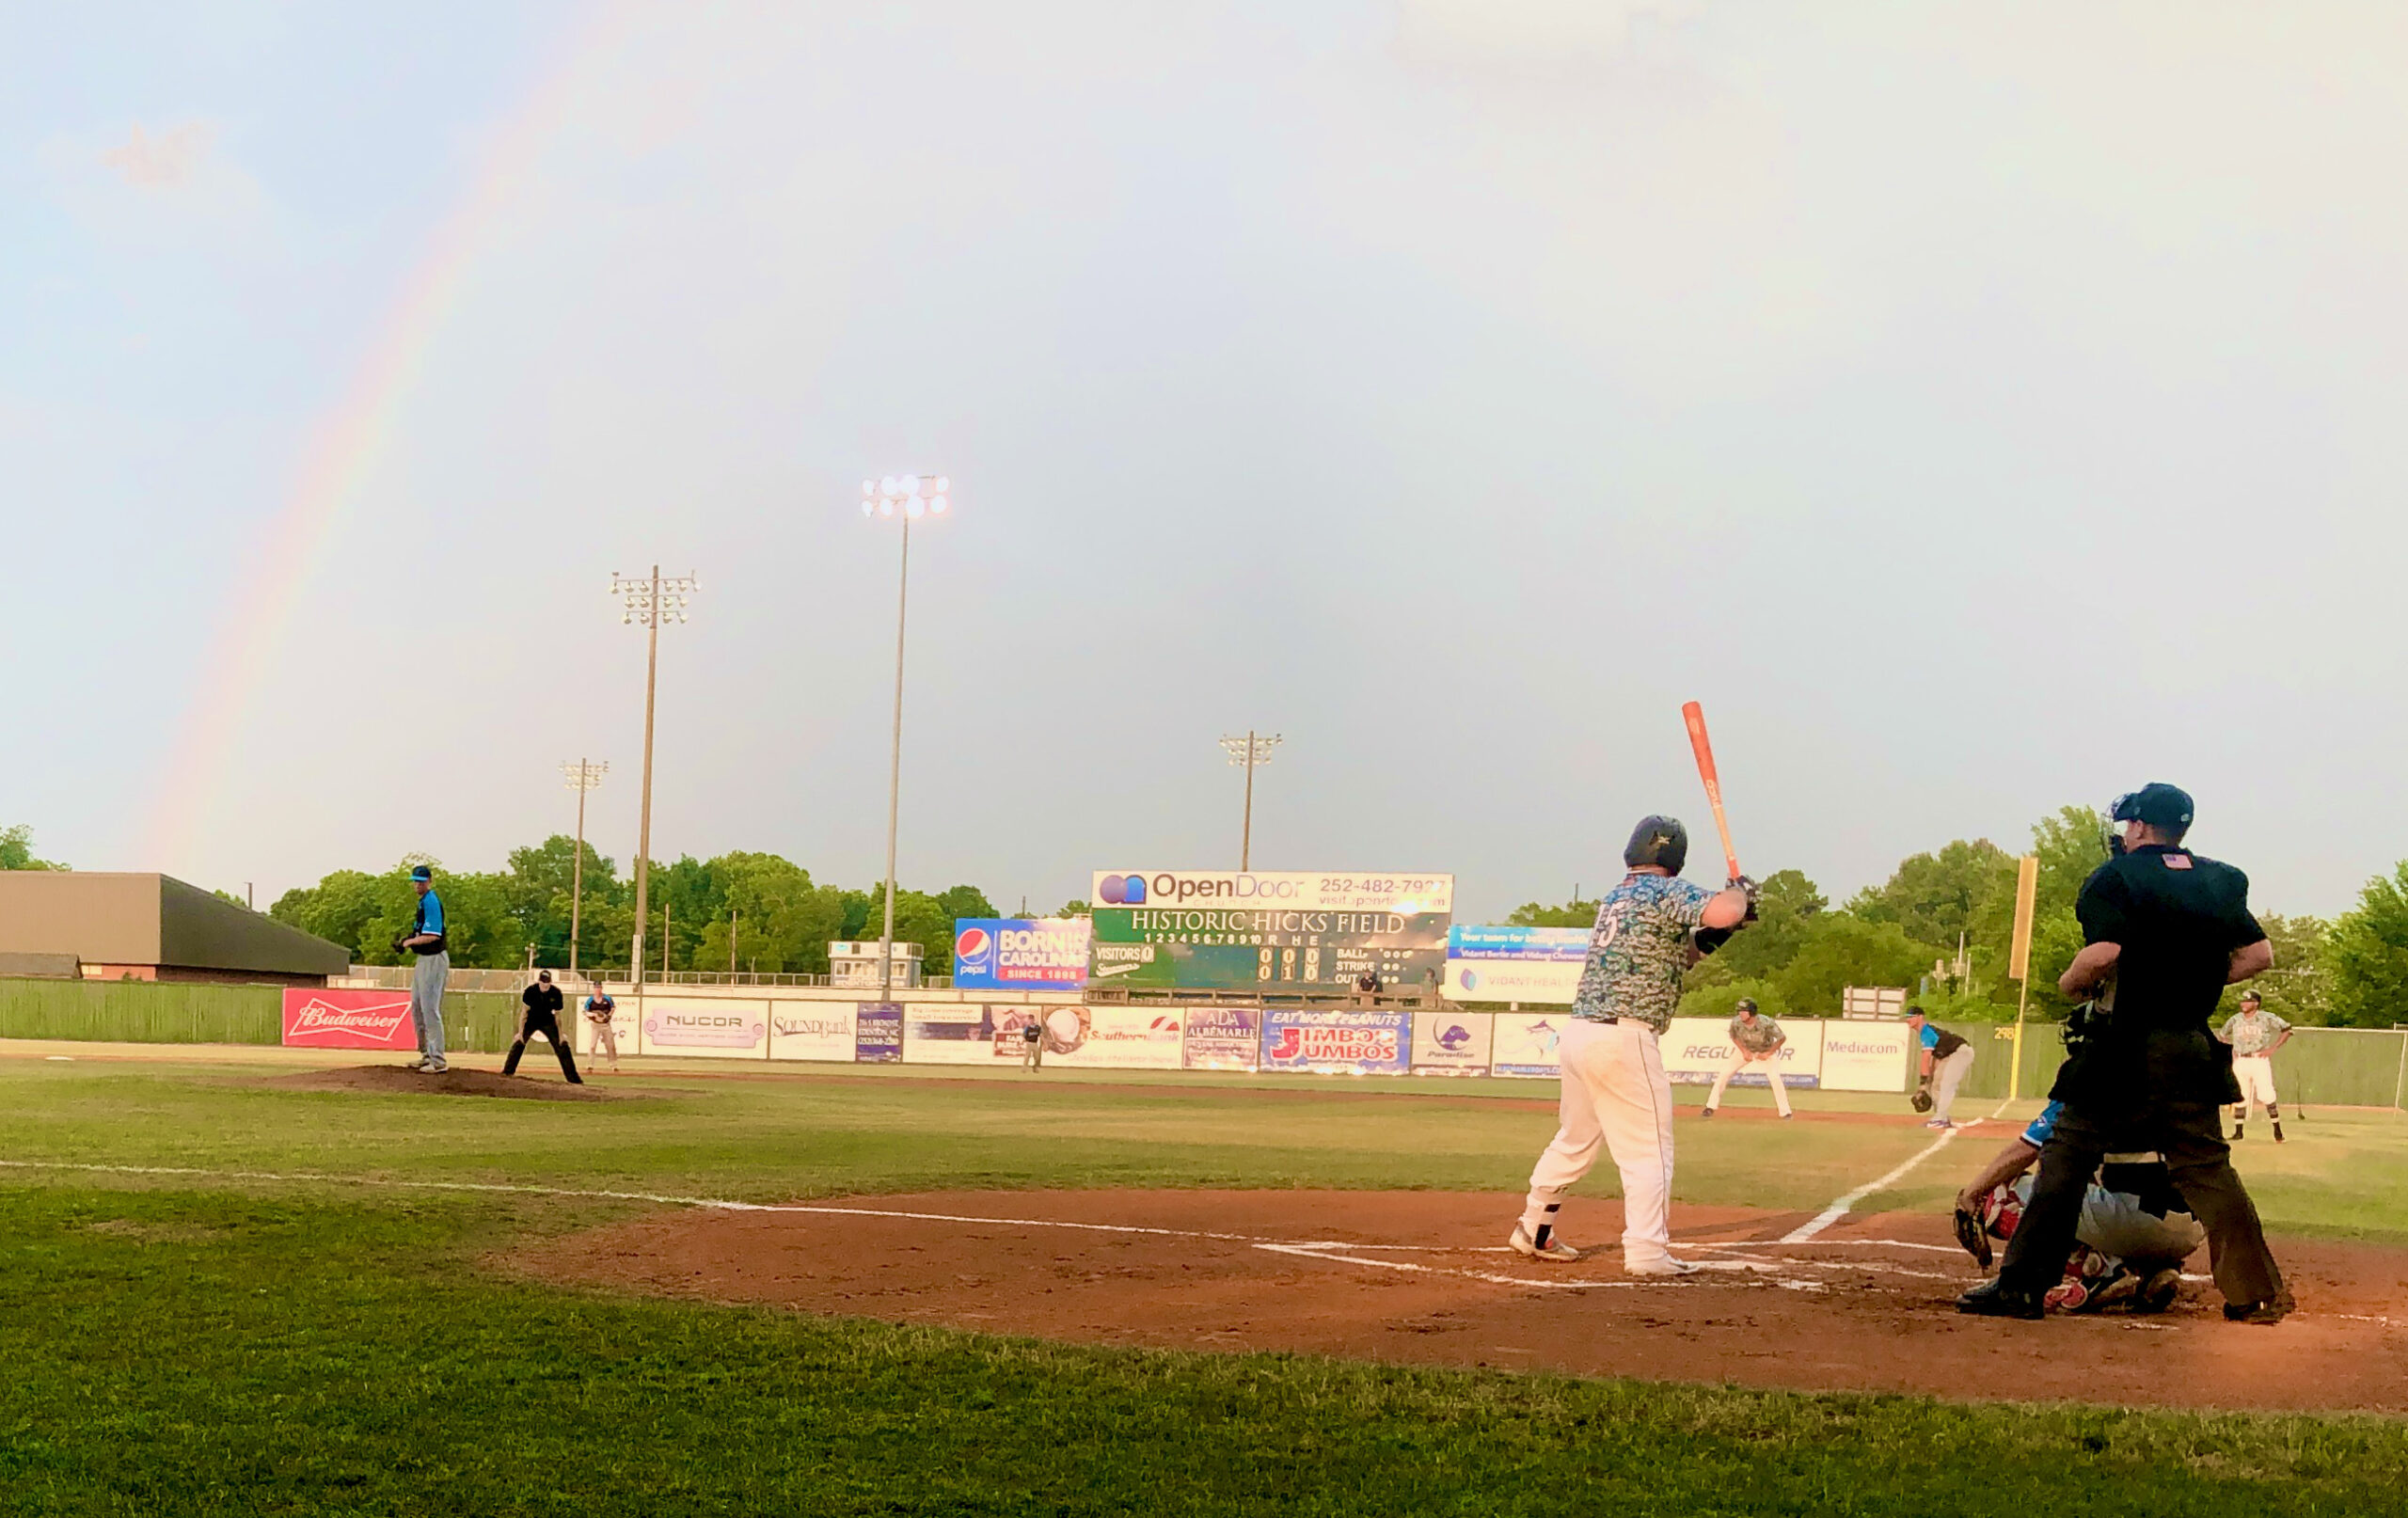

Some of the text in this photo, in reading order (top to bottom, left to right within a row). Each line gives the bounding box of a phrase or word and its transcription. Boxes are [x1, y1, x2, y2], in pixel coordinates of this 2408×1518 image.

[1152, 873, 1305, 903] OpenDoor
[1132, 910, 1406, 934] HISTORIC HICKS FIELD
[999, 929, 1065, 952] BORN
[1145, 933, 1151, 942] 1
[1156, 933, 1164, 943] 2
[1167, 933, 1176, 943] 3
[1180, 933, 1188, 943] 4
[1192, 934, 1200, 944] 5
[1203, 934, 1212, 944] 6
[1216, 934, 1225, 944] 7
[1227, 934, 1235, 944] 8
[1239, 934, 1247, 944] 9
[1249, 934, 1261, 945] 10
[1268, 935, 1278, 945] R
[1308, 936, 1319, 946] E
[1096, 947, 1140, 960] VISITORS
[1259, 948, 1320, 964] 0 0 0
[1337, 949, 1364, 958] BALL
[959, 965, 987, 975] pepsi
[1259, 965, 1319, 981] 0 1 0
[1336, 961, 1376, 972] STRIKE
[1007, 970, 1042, 979] SINCE
[1335, 973, 1358, 984] OUT
[299, 1006, 400, 1028] Budweiser
[666, 1016, 743, 1027] NUCOR
[1272, 1012, 1298, 1023] EAT
[1993, 1027, 2015, 1040] 298
[1827, 1040, 1898, 1054] Mediacom
